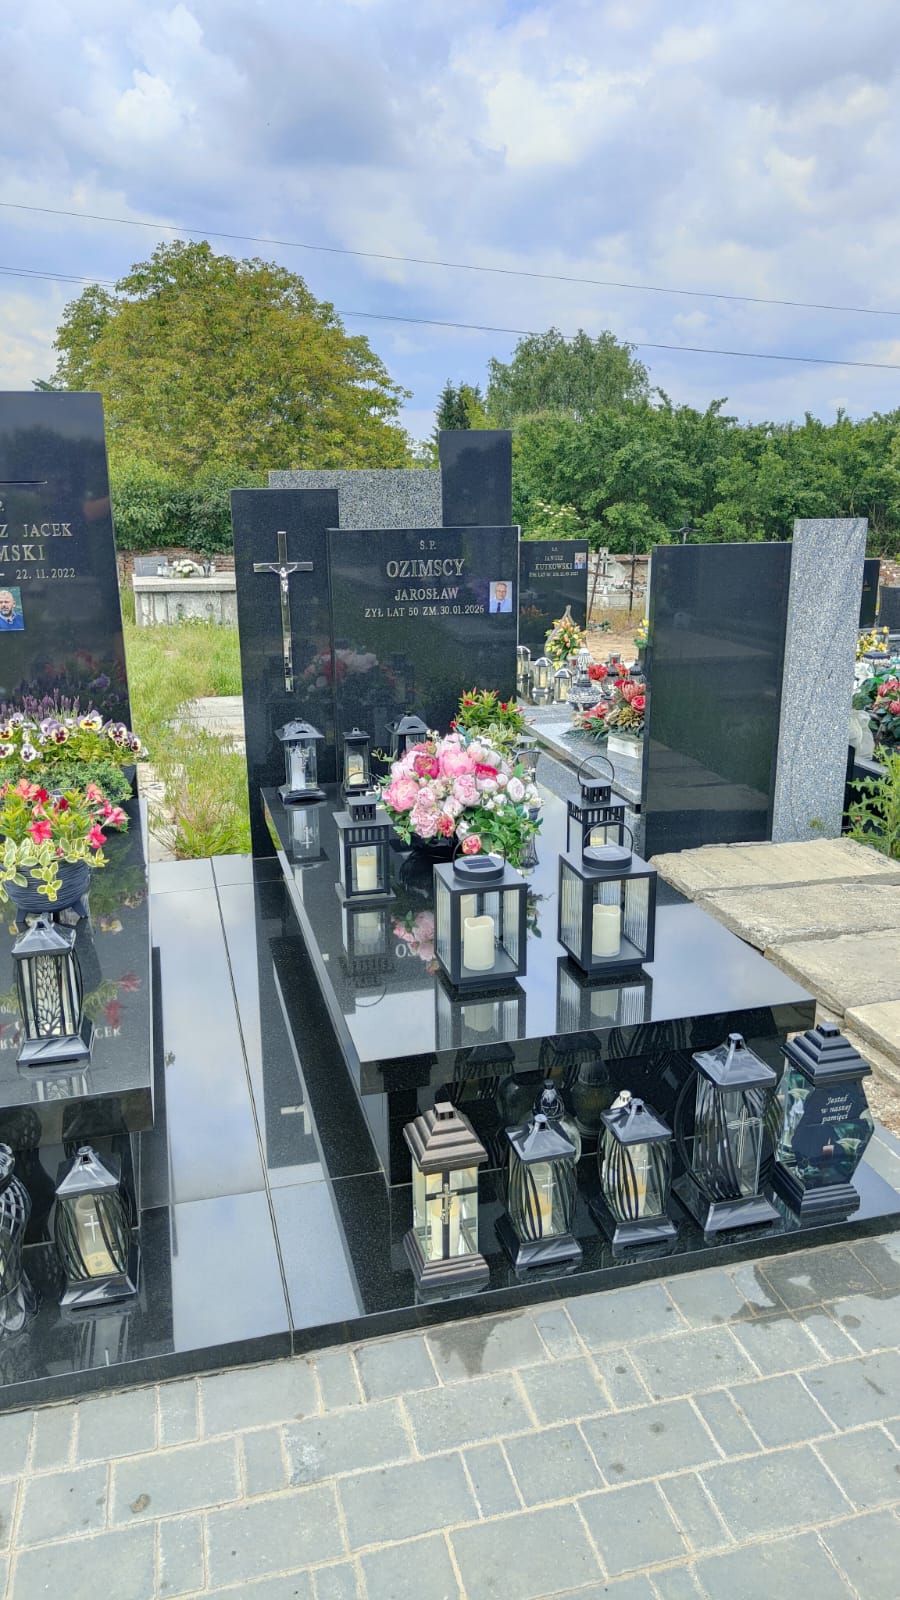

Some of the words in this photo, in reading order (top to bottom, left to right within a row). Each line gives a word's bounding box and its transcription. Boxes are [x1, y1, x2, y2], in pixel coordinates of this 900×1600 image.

[23, 523, 73, 537] JACEK
[386, 559, 465, 578] OZIMSCY
[394, 587, 459, 601] JAROSŁAW
[387, 607, 405, 617] LAT
[408, 606, 419, 616] 50
